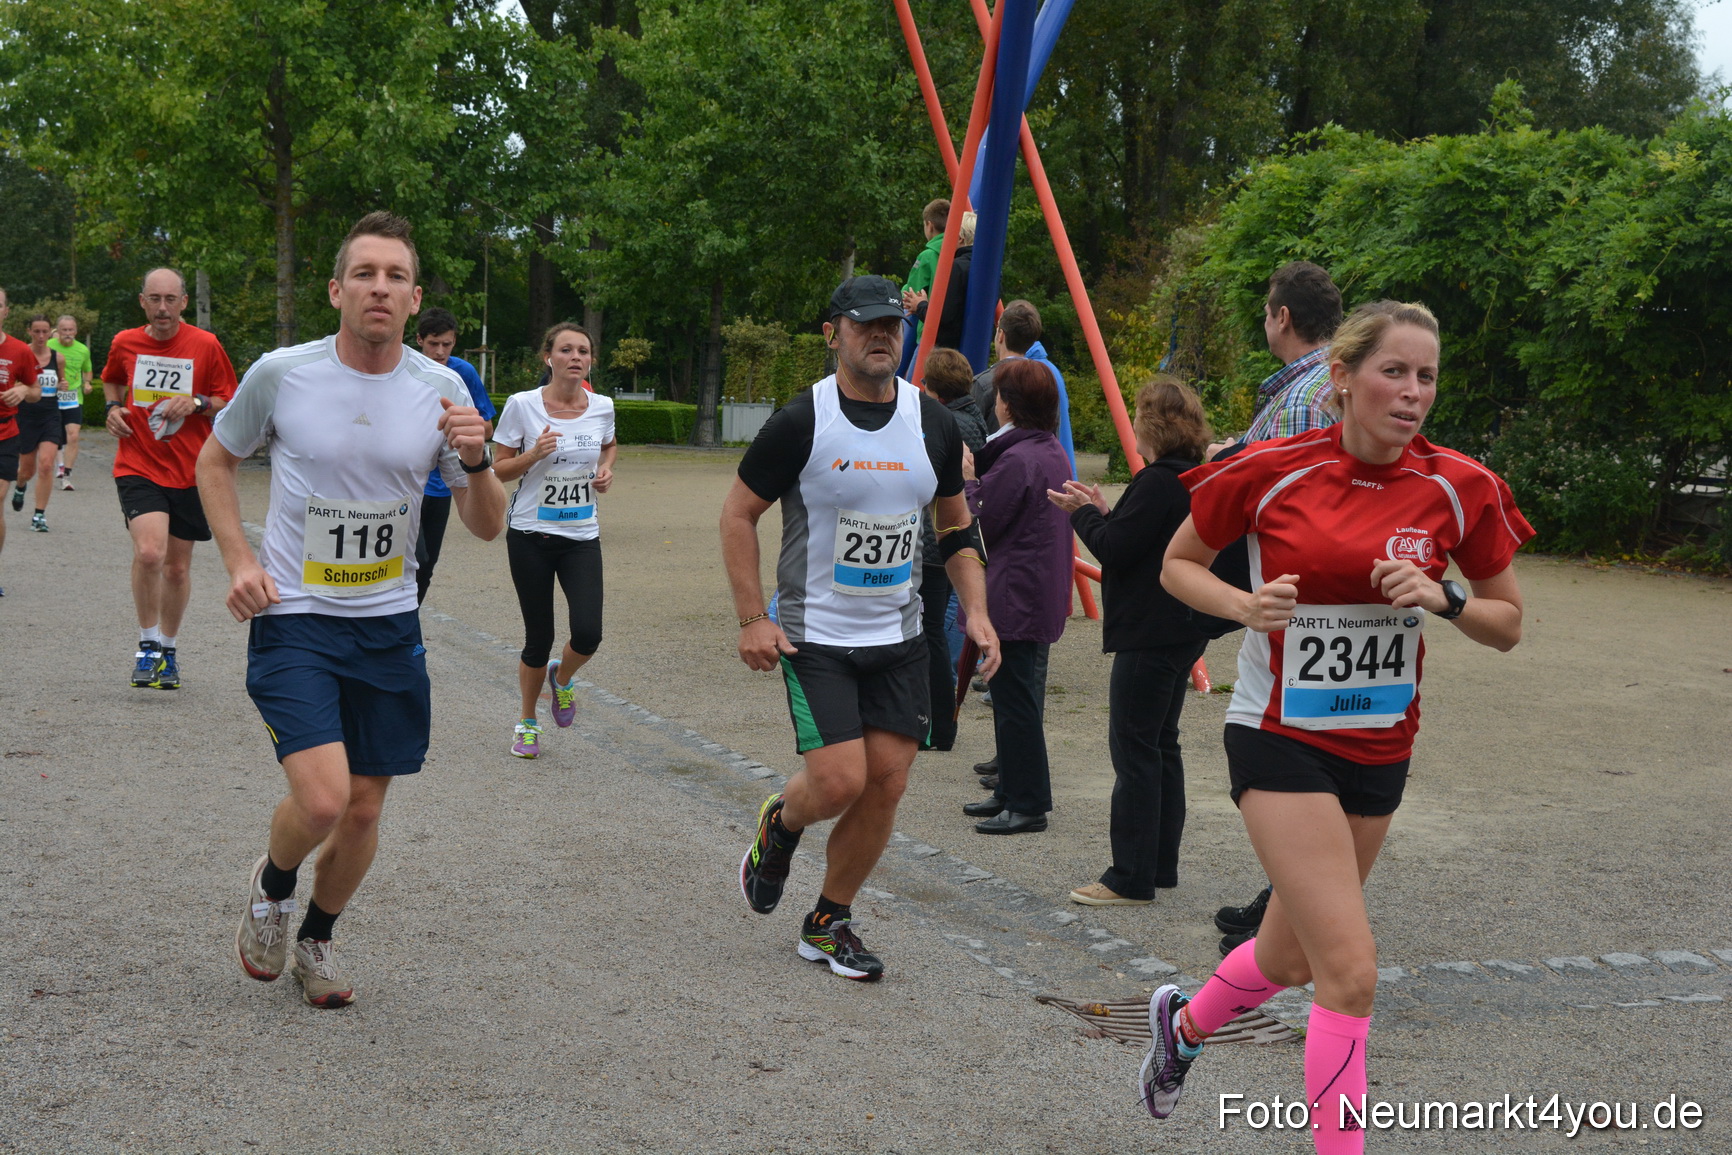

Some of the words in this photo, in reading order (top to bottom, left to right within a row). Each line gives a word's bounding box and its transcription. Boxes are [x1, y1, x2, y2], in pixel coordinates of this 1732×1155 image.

[156, 361, 183, 370] Neumarkt
[145, 368, 181, 391] 272
[853, 460, 910, 472] KLEBL
[562, 474, 588, 482] Neumarkt
[1351, 478, 1377, 489] CRAFT
[544, 482, 590, 505] 2441
[308, 506, 345, 519] PARTL
[348, 509, 397, 520] Neumarkt
[558, 511, 579, 519] Anne
[839, 517, 871, 531] PARTL
[873, 518, 909, 531] Neumarkt
[328, 523, 394, 559] 118
[843, 529, 913, 565] 2378
[323, 564, 389, 583] Schorschi
[863, 572, 895, 585] Peter
[1288, 616, 1335, 630] PARTL
[1338, 616, 1398, 629] Neumarkt
[1298, 633, 1406, 683] 2344
[1329, 694, 1372, 712] Julia
